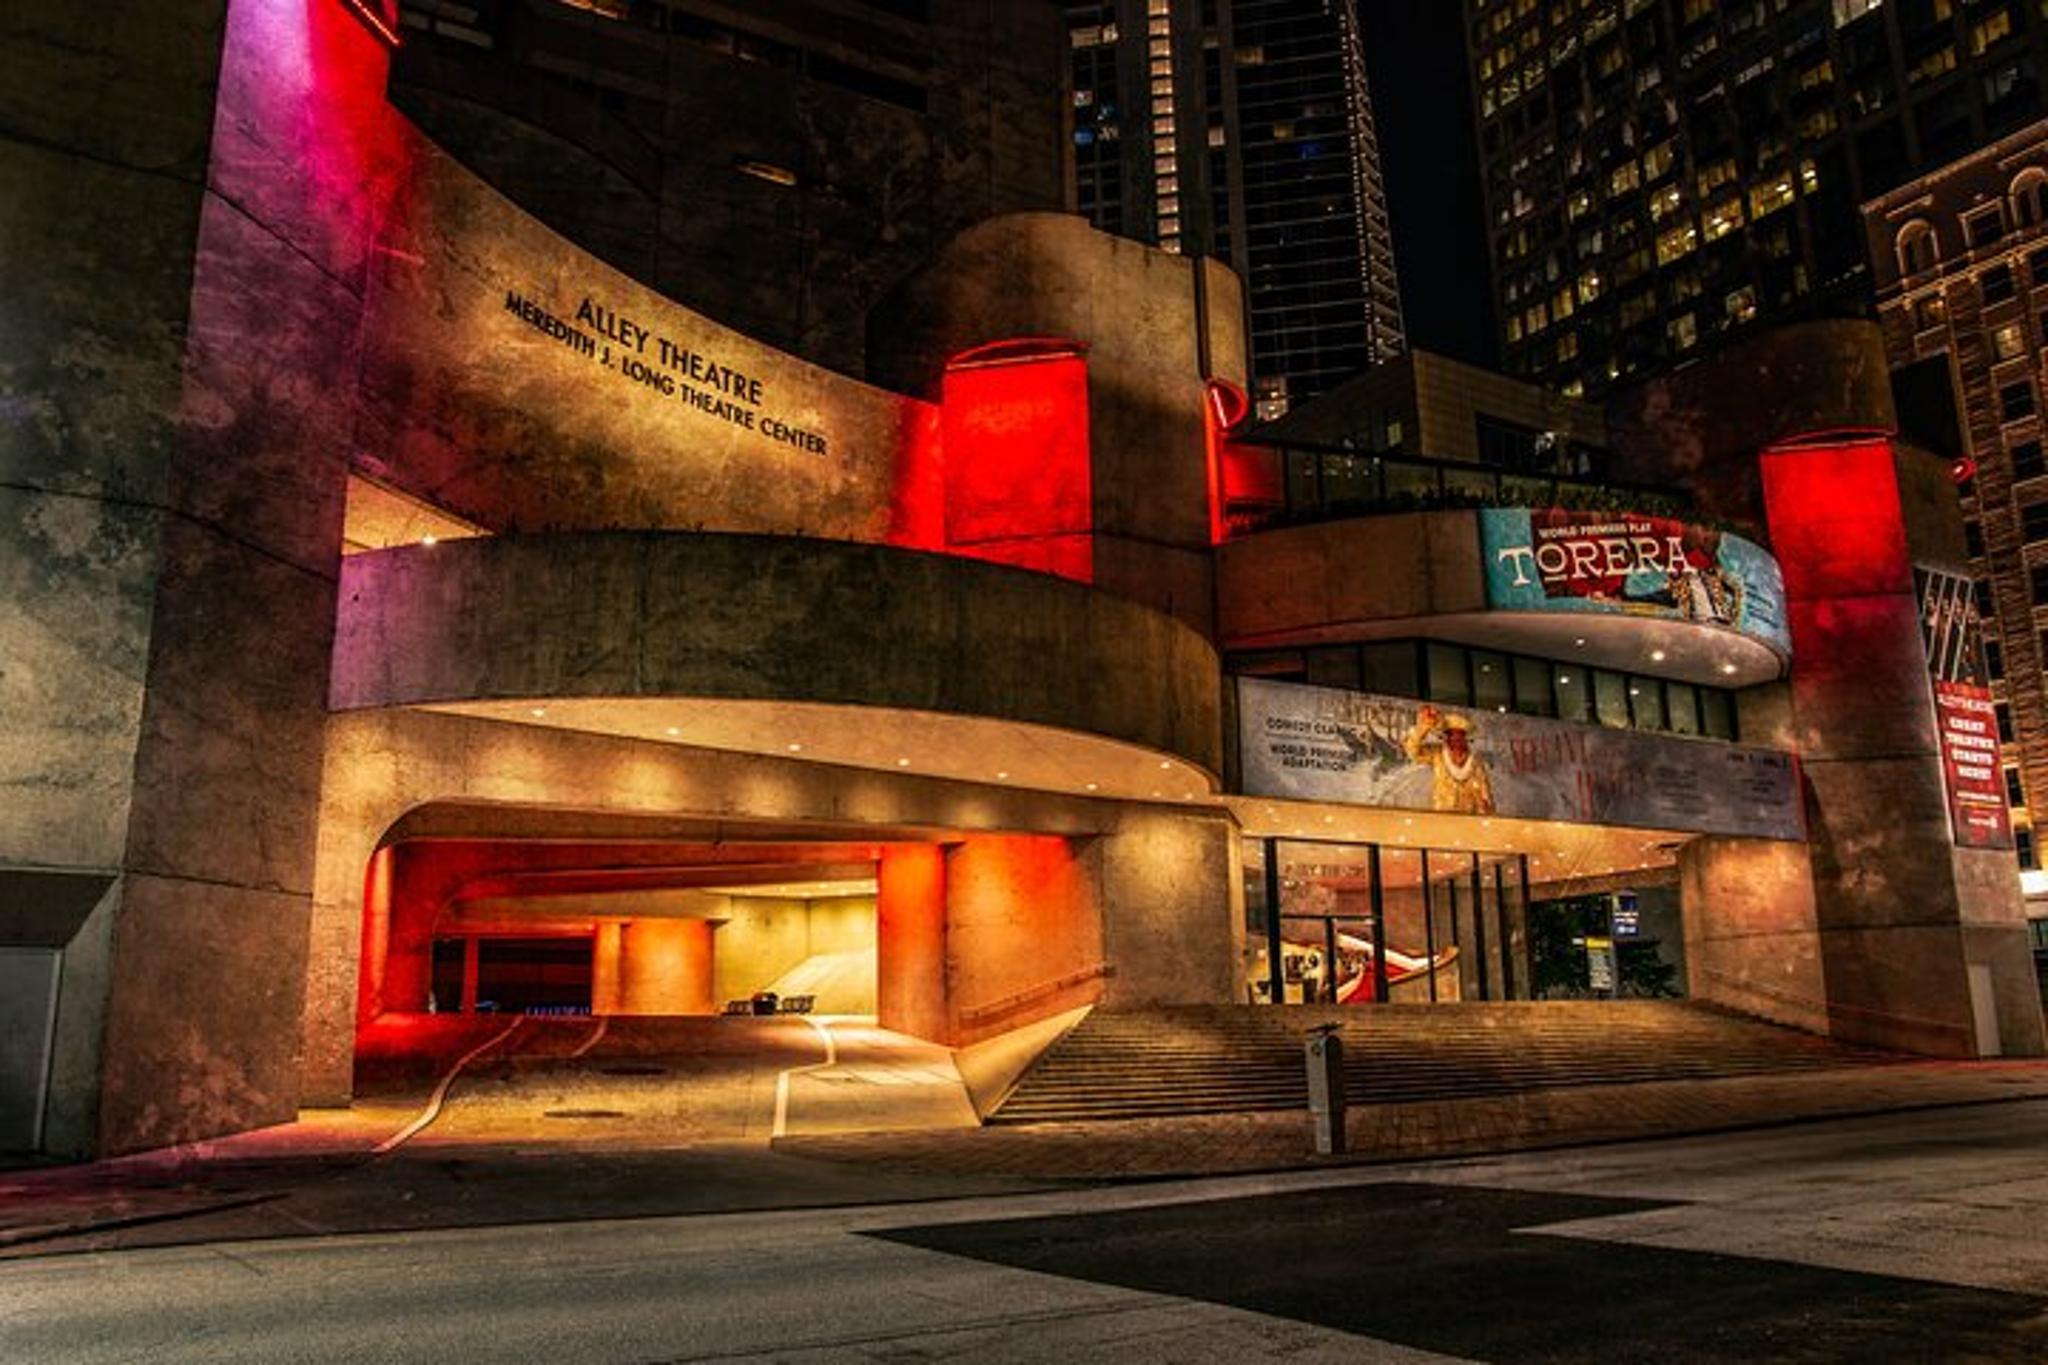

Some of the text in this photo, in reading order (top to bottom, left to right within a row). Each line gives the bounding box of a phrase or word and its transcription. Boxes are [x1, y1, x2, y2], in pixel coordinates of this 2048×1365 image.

[576, 298, 762, 406] ALLEY THEATRE
[504, 290, 827, 456] MEREDITH J. LONG THEATRE CENTER
[1538, 522, 1651, 539] WORLD PREMIERE PLAY
[1498, 536, 1698, 586] TORERA
[1266, 717, 1311, 733] COMEDY
[1271, 744, 1307, 757] WORLD
[1282, 756, 1347, 771] ADAPTATION
